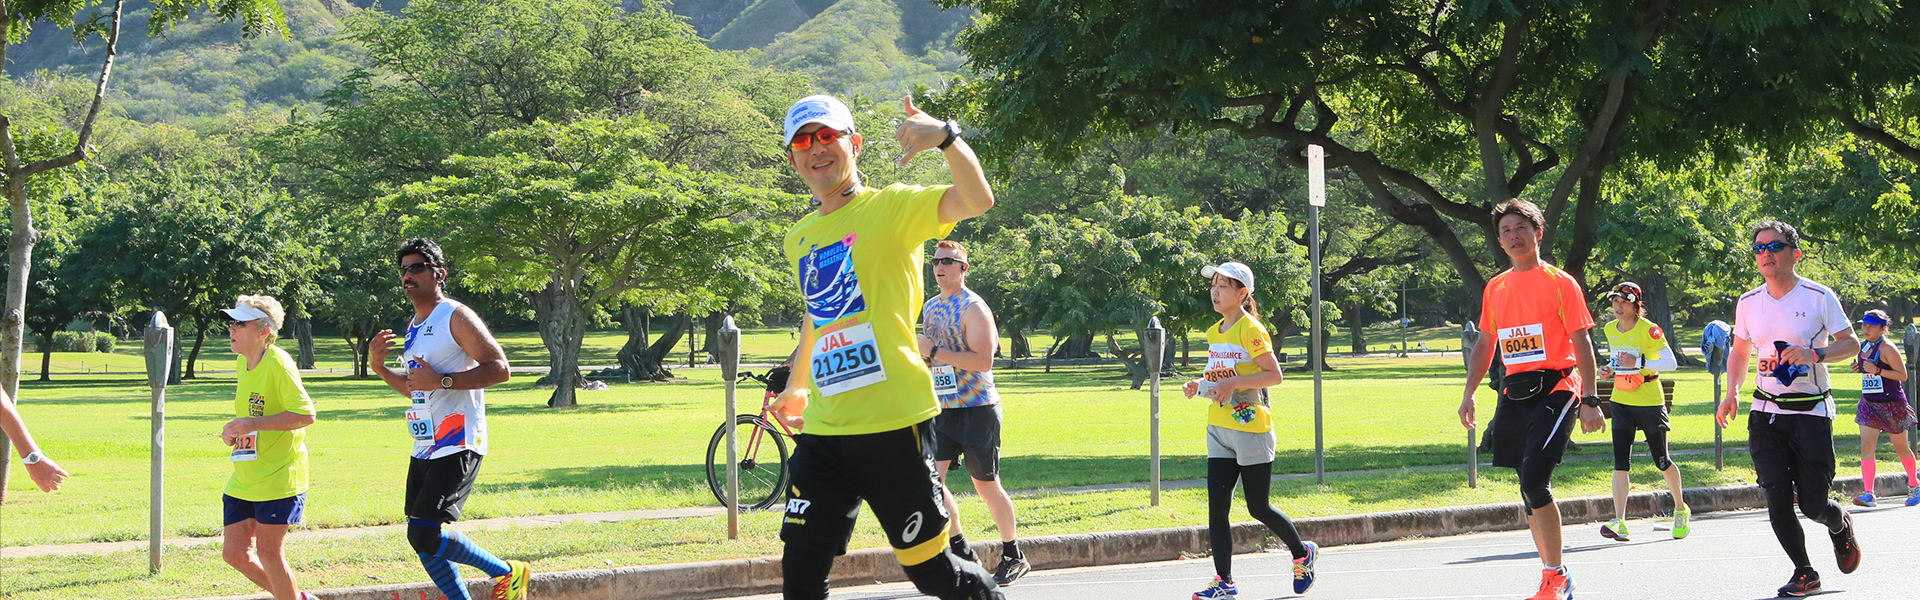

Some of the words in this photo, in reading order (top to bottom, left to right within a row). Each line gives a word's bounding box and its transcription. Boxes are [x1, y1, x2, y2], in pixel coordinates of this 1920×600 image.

[1509, 327, 1531, 338] JAL
[822, 332, 853, 352] JAL
[1505, 337, 1538, 353] 6041
[813, 344, 877, 379] 21250
[1210, 351, 1242, 360] RENAISSANCE
[1211, 361, 1226, 370] JAL
[1205, 369, 1236, 382] 28590
[406, 412, 421, 421] AL
